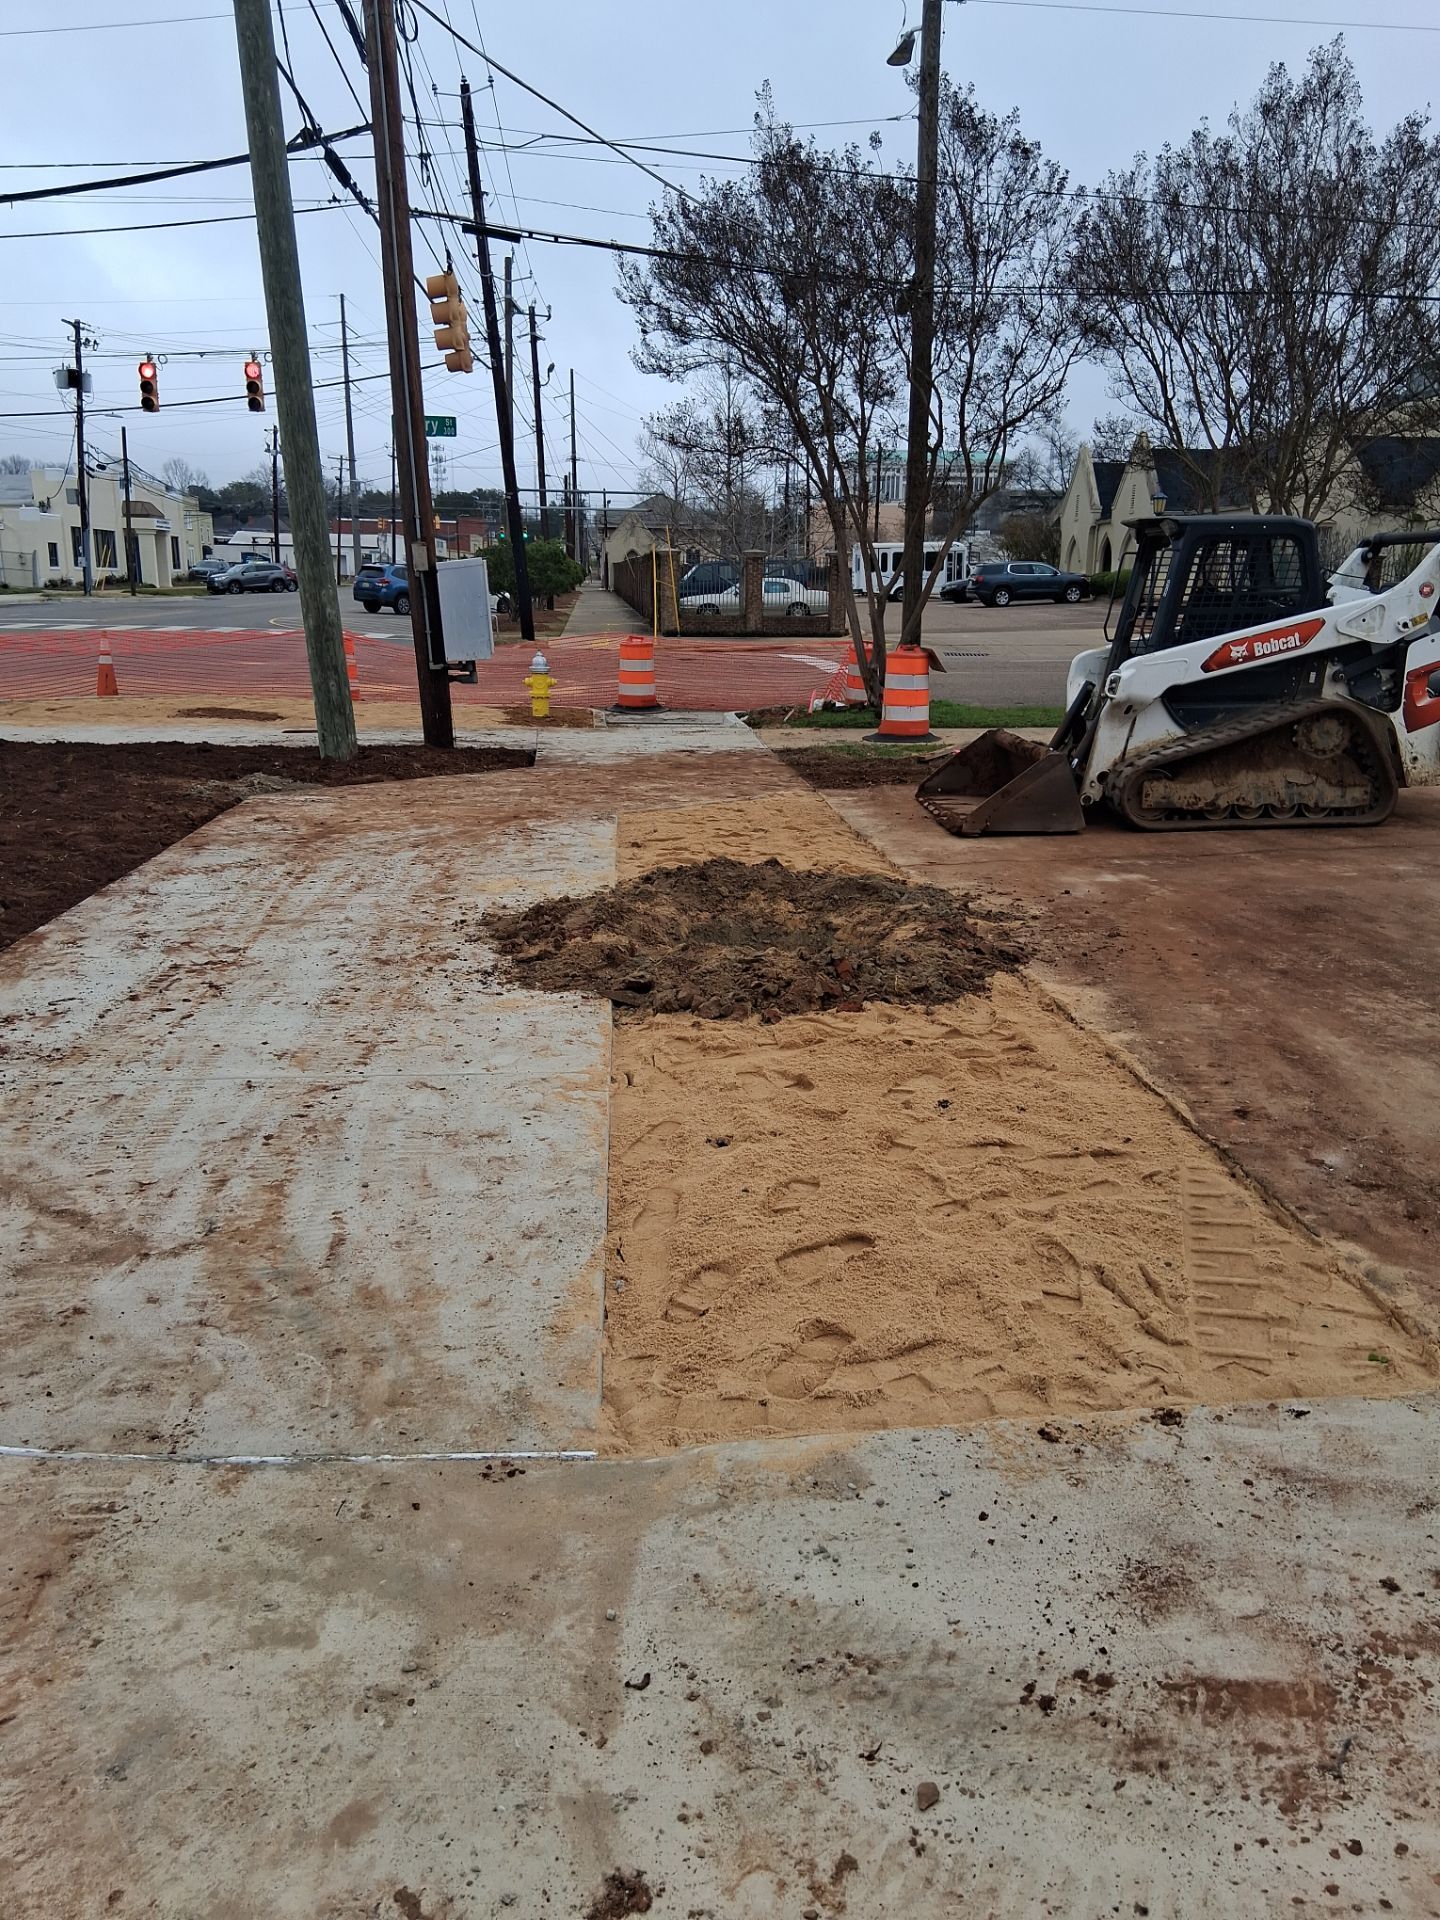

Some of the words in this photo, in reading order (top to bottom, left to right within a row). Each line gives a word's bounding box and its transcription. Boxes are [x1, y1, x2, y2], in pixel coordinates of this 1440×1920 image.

[424, 420, 439, 435] ry
[445, 418, 453, 426] St
[1253, 632, 1301, 657] Bobcat
